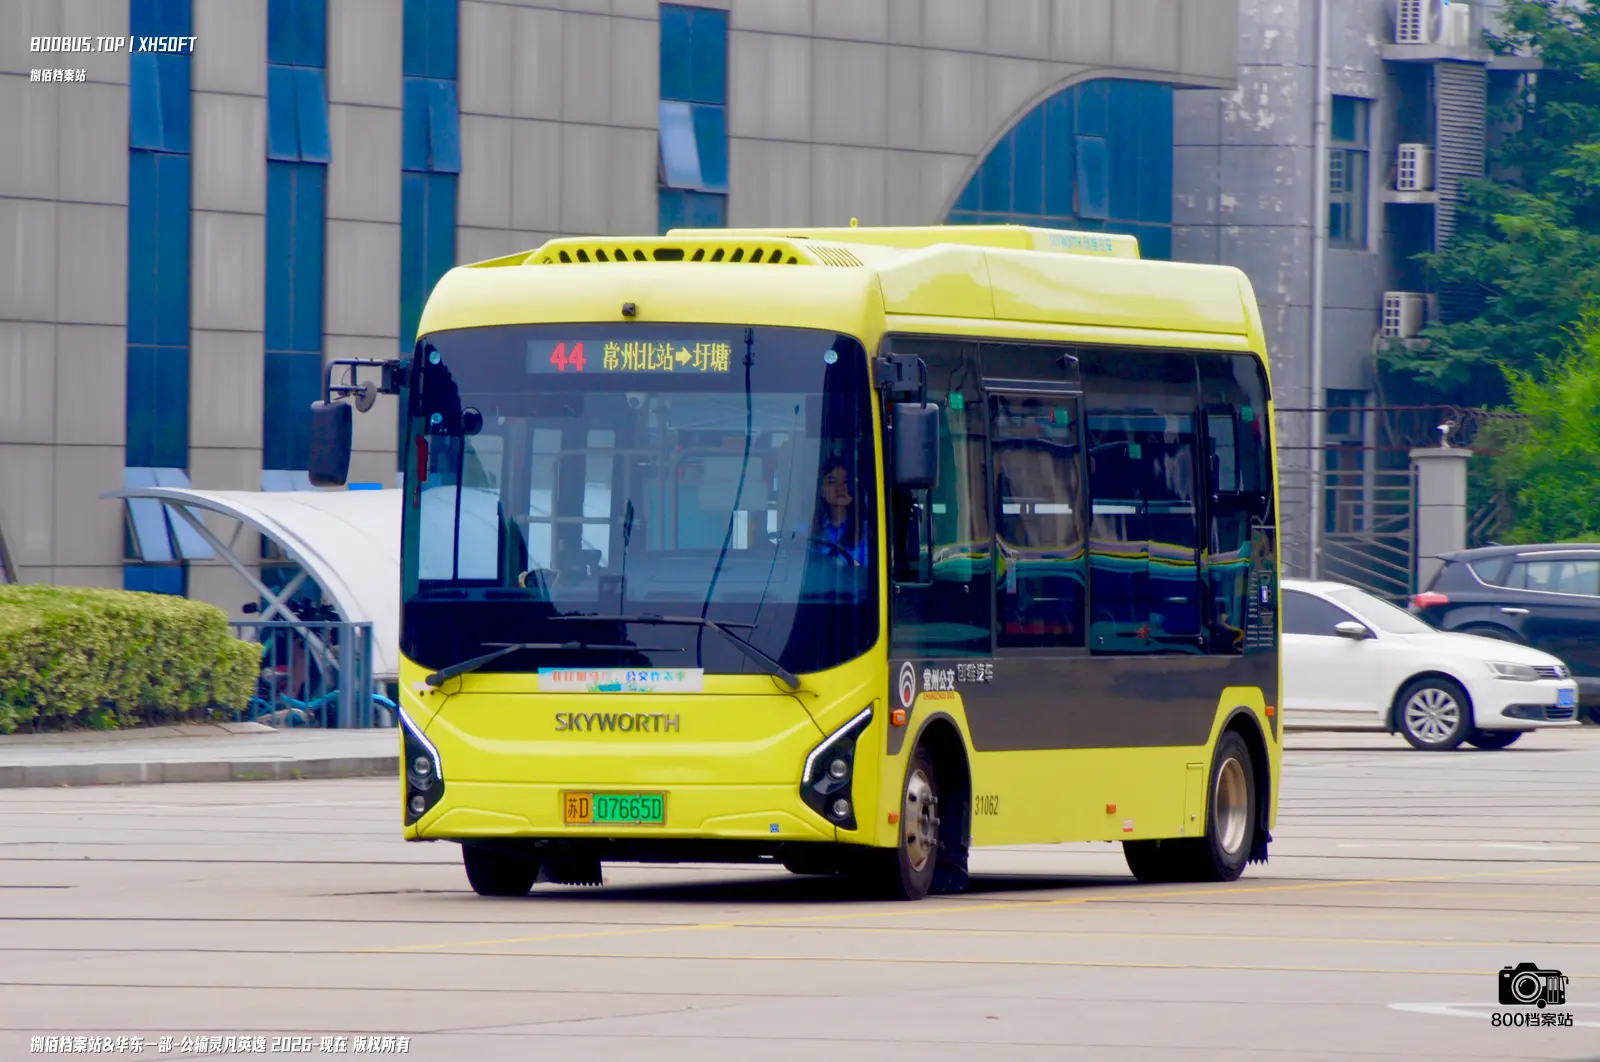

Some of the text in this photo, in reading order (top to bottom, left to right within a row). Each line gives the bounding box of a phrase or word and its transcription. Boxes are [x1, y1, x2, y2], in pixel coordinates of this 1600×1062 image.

[550, 341, 731, 371] 44 常州北站 圩塘
[923, 668, 955, 691] 常州公交
[555, 711, 679, 732] SKYWORTH
[568, 798, 662, 819] 苏D 07665D
[975, 795, 999, 816] 31062
